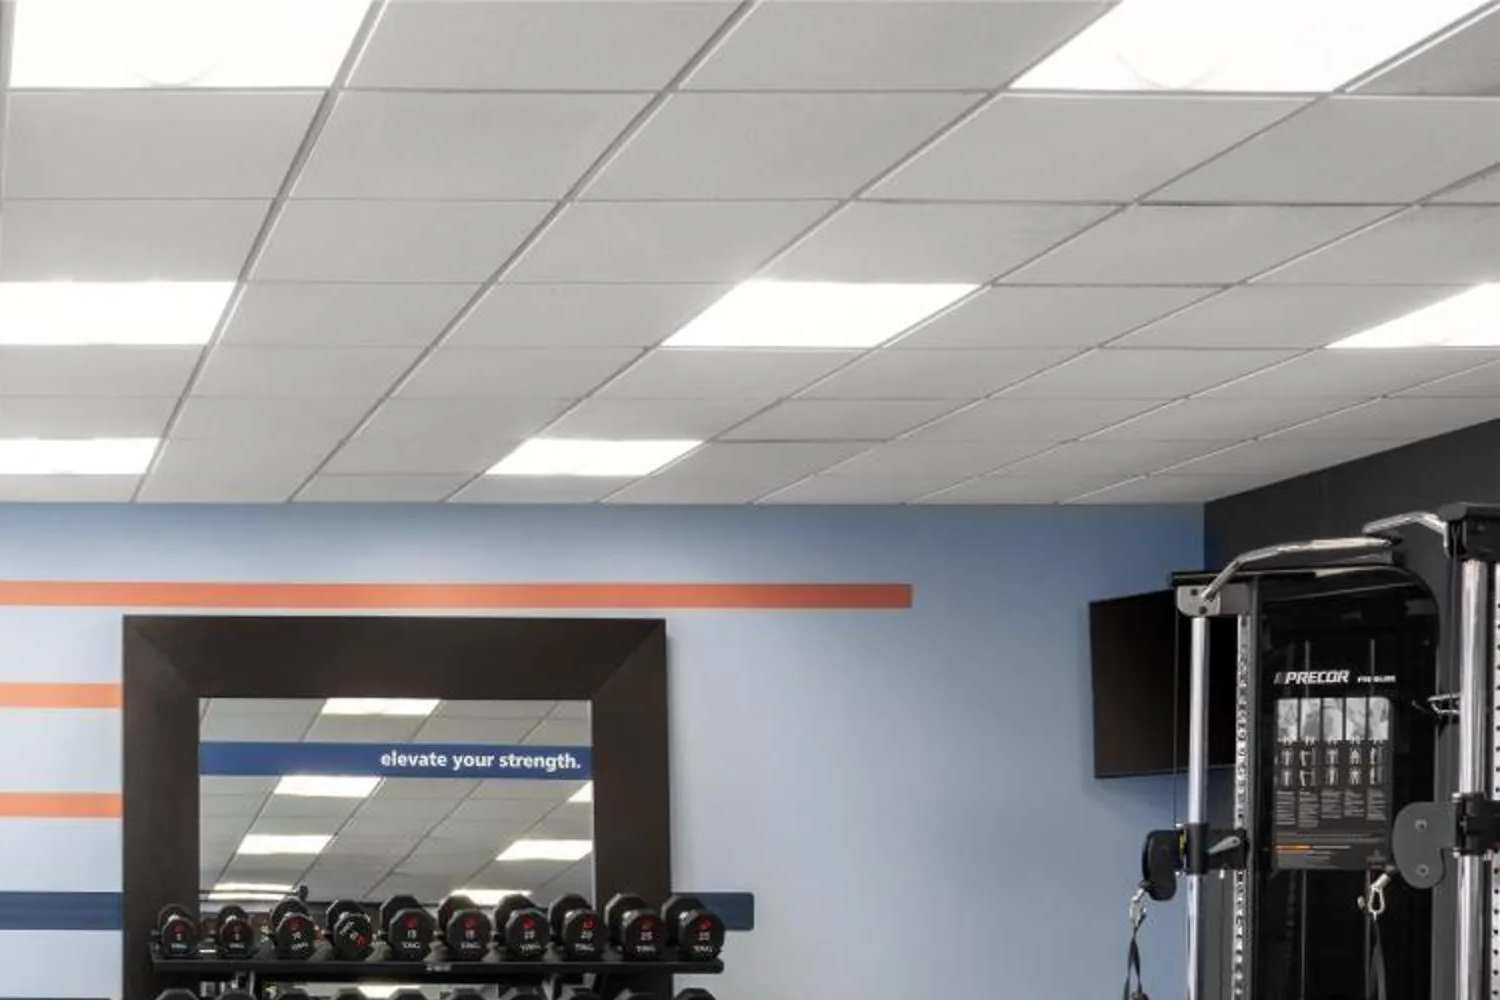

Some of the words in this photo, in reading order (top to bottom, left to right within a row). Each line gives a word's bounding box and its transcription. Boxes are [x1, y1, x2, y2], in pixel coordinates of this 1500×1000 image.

[1284, 670, 1350, 685] PRECOR
[380, 750, 448, 767] elevate
[452, 754, 495, 771] your
[499, 753, 582, 772] strength.
